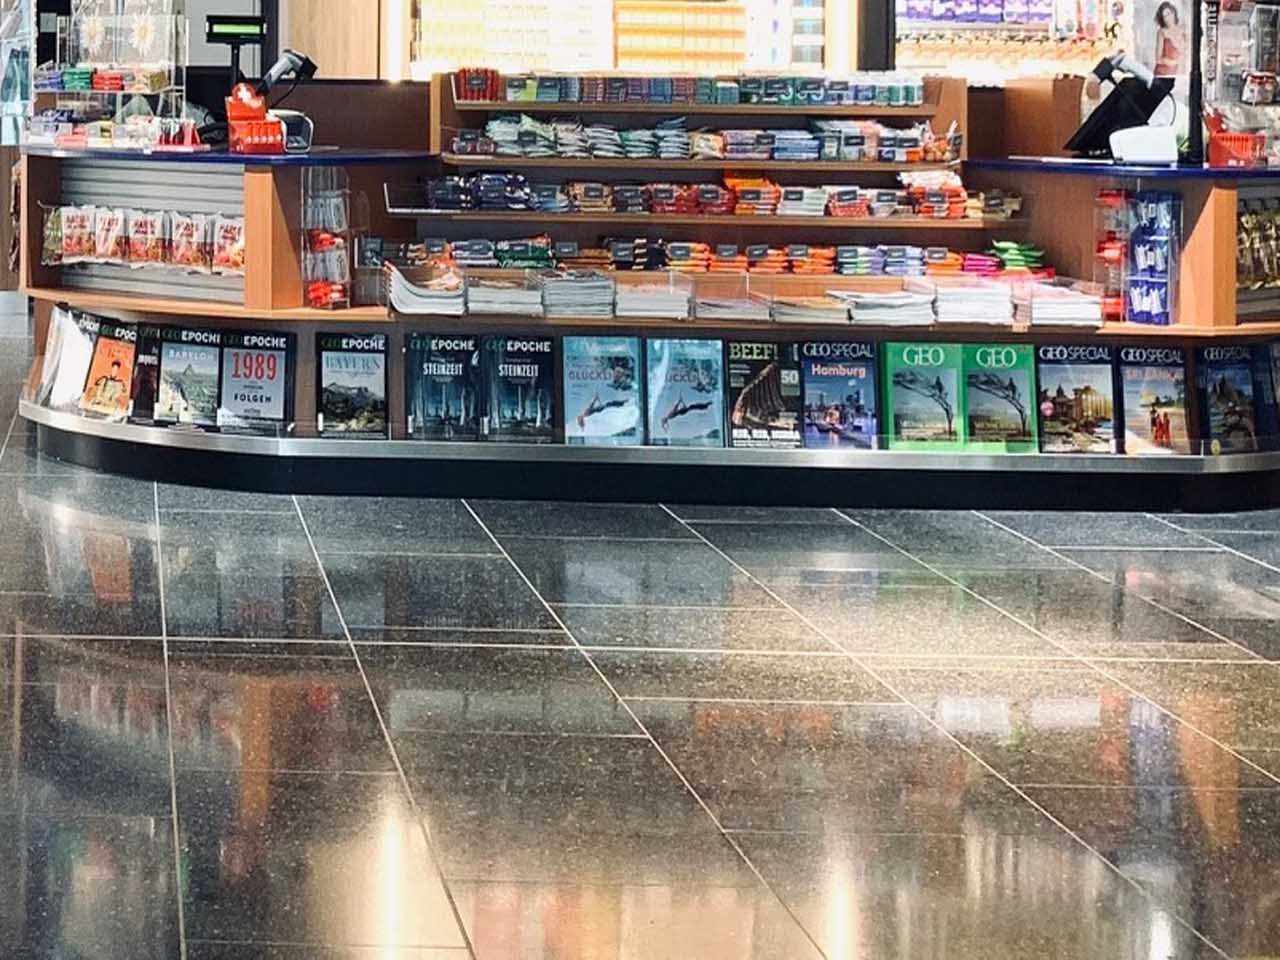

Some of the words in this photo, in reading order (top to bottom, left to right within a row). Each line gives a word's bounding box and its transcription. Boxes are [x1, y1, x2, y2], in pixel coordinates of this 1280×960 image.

[181, 330, 220, 345] EPOCH
[243, 335, 287, 349] EPOCHE
[341, 338, 385, 351] EPOCHE
[431, 338, 475, 352] EPOCHE
[507, 340, 552, 353] EPOCHE
[729, 342, 778, 360] BEEF!
[903, 345, 945, 366] GEO
[976, 346, 1017, 368] GEO
[231, 351, 278, 382] 1989
[422, 362, 463, 376] STEINZEIT
[497, 363, 539, 377] STEINZEIT
[811, 363, 866, 379] Hamburg
[781, 369, 800, 386] 50
